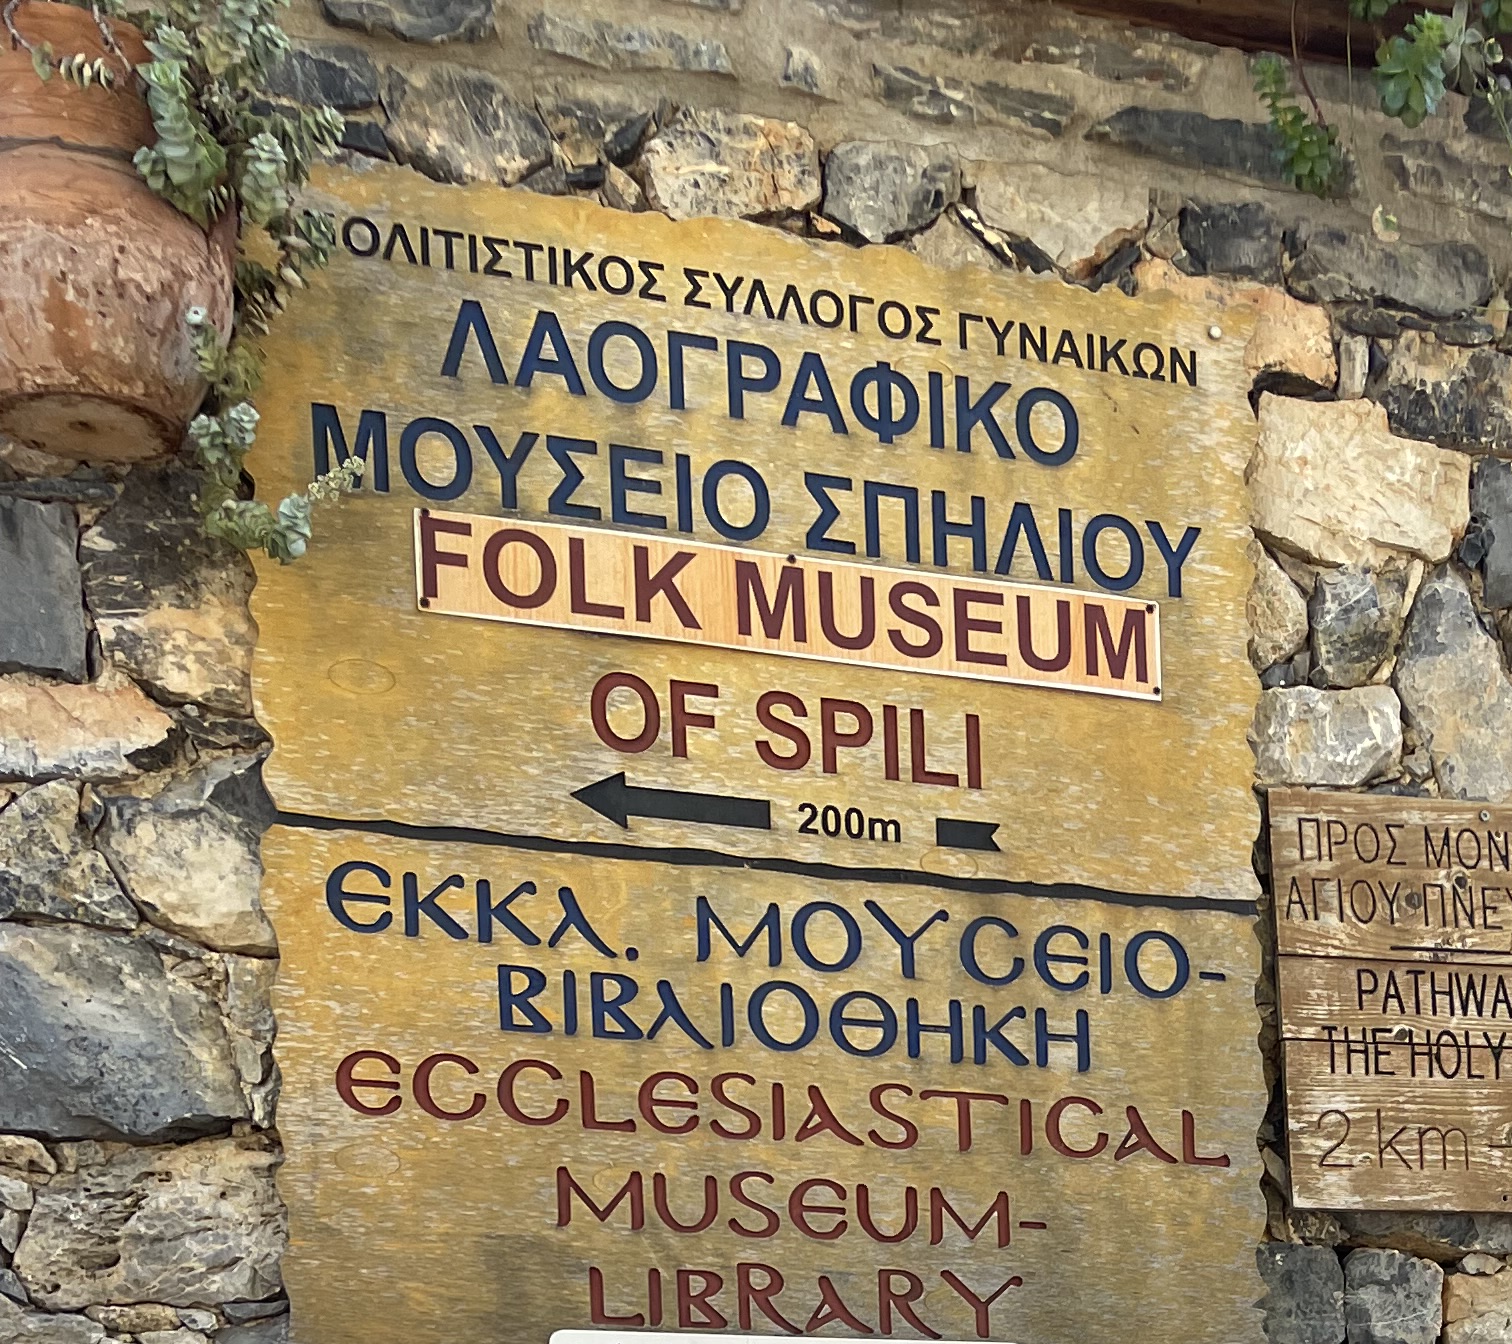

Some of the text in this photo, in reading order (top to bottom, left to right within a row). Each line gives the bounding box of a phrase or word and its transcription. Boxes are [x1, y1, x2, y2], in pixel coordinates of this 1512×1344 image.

[303, 208, 1197, 387] ΟΛΙΤΙΣΤΙΚΟΣ ΣΥΛΛΟΓΟΣ ΓΥΝΑΙΚΩΝ
[441, 300, 1079, 466] ΛΑΟΓΡΑΦΙΚΟ
[312, 403, 1201, 598] ΜΟΥΣΕΙΟ ΣΠΗΛΙΟΥ
[423, 519, 1150, 684] FOLK MUSEUM
[591, 672, 982, 789] OF SPILI
[799, 805, 900, 843] 200m
[1297, 818, 1406, 865] ΠΡΟΣ
[1286, 877, 1400, 924] ΑΓΙΟΥ
[497, 964, 1090, 1072] ΒΙΒΛΙΟΘΗΚΗ
[1321, 1026, 1395, 1076] THE
[1408, 1030, 1506, 1080] HOLY
[335, 1051, 1230, 1168] ECCLESIASTICAL
[1316, 1109, 1469, 1170] 2 km
[557, 1167, 1047, 1249] MUSEUM-
[588, 1264, 1022, 1340] LIBRARY
